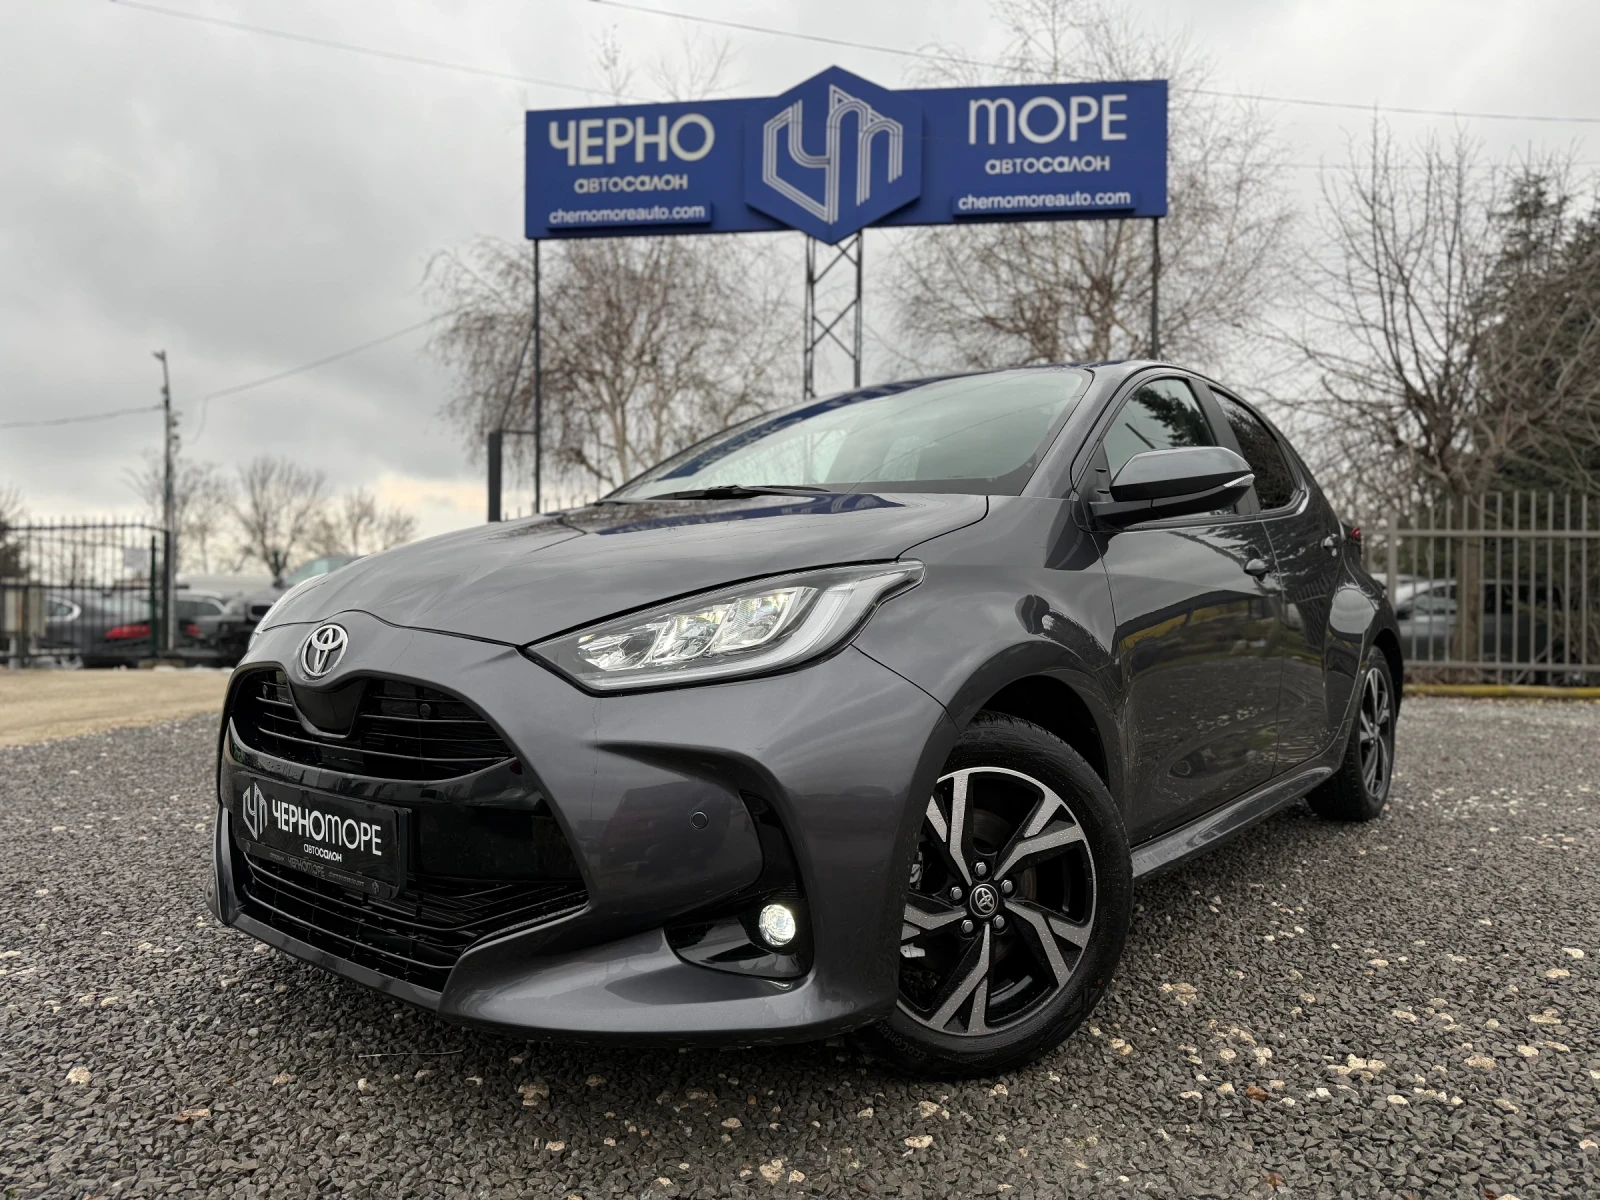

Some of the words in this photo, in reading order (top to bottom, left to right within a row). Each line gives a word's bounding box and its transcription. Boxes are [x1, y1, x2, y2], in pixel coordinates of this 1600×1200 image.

[549, 113, 715, 166] ЧЕРНО
[985, 155, 1110, 174] автосалон
[574, 174, 688, 193] автосалон
[958, 191, 1131, 210] chernomoreauto.com
[549, 205, 705, 224] chernomoreauto.com
